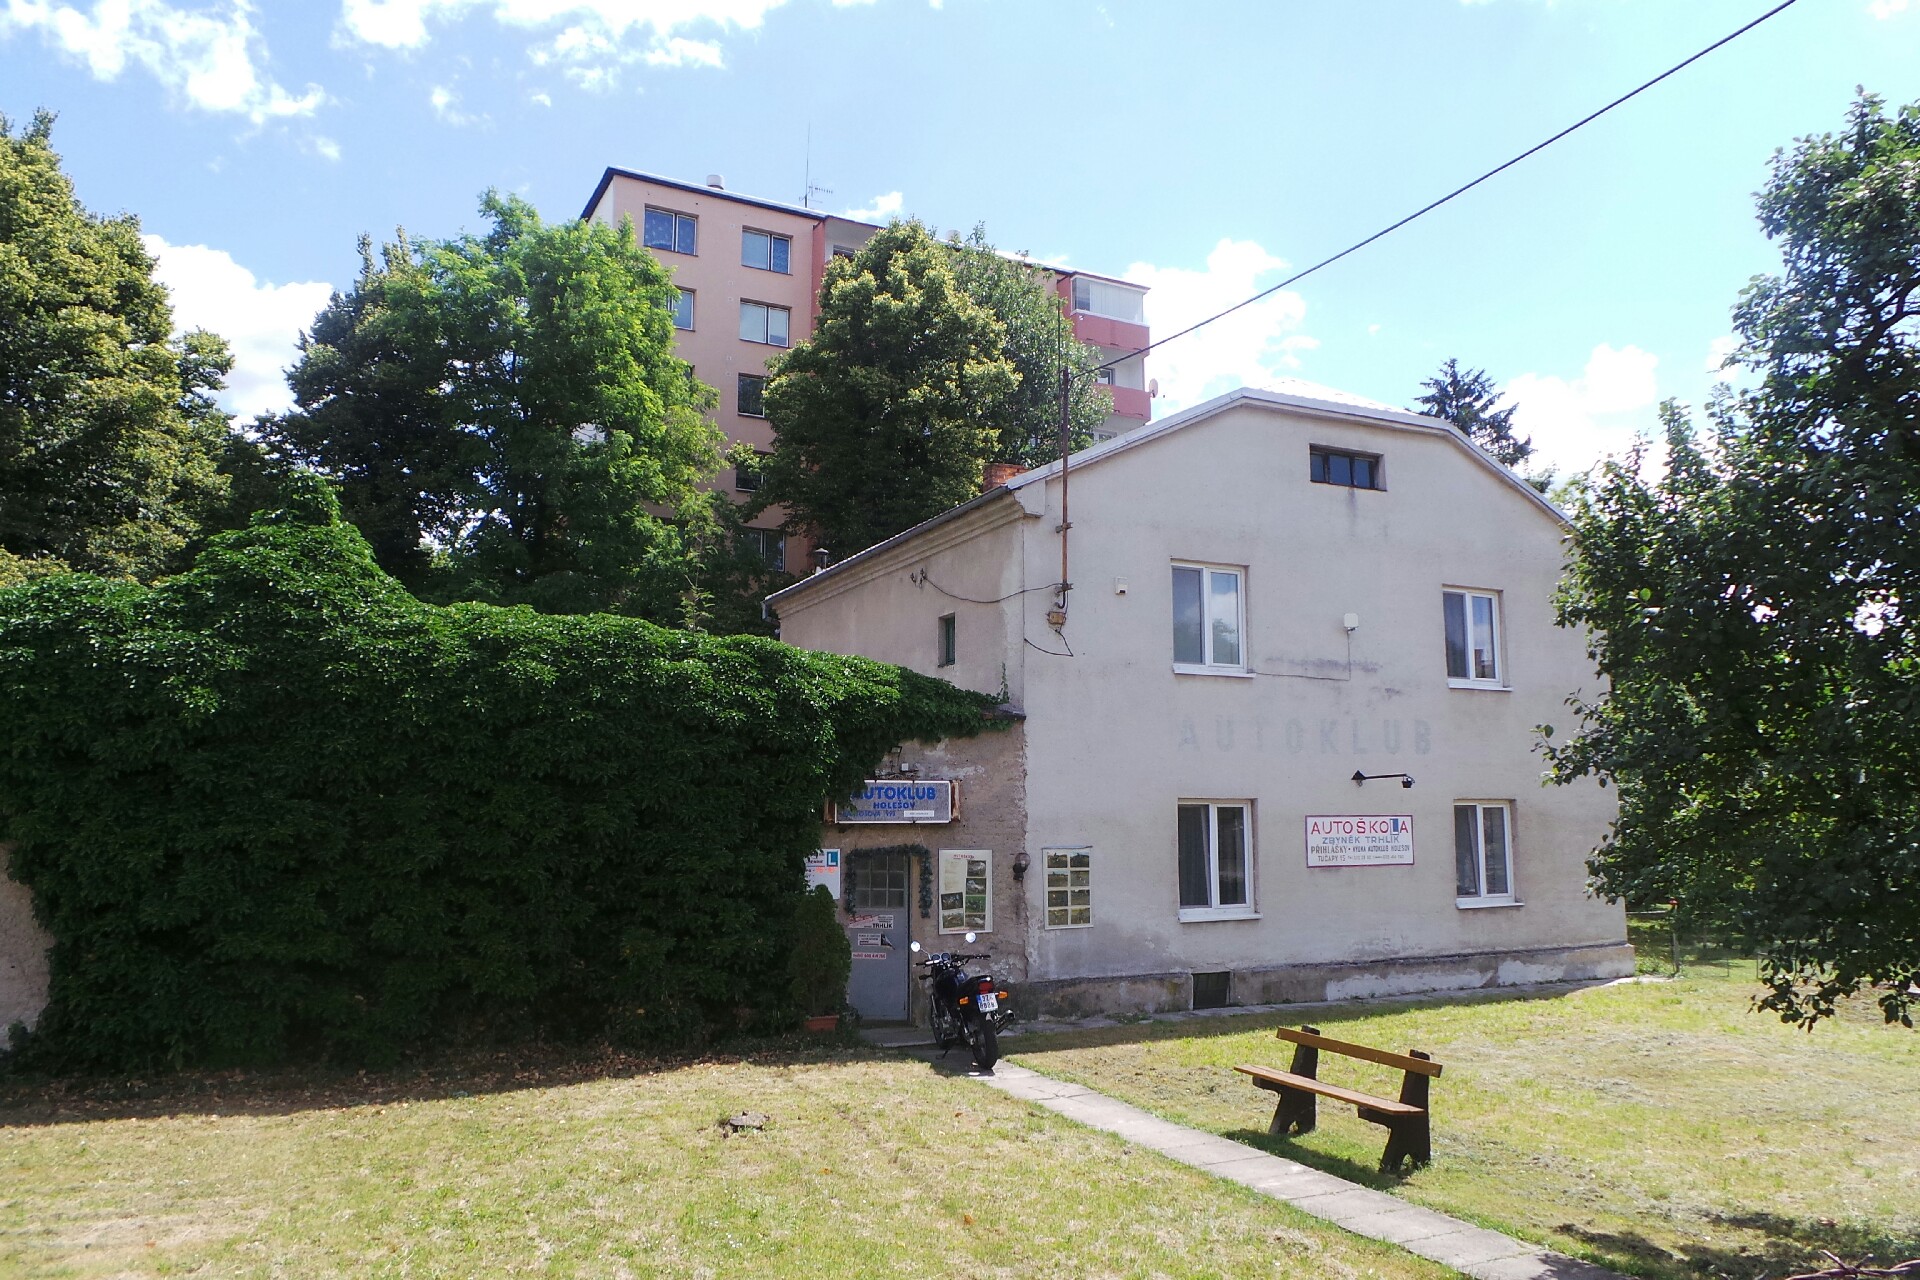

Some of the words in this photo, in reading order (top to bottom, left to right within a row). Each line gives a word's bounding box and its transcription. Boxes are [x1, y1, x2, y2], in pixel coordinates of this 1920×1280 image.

[1177, 718, 1432, 755] AUTOKLUB
[873, 800, 915, 809] HOLEŠOV
[1311, 818, 1409, 836] AUTOŠKOLA
